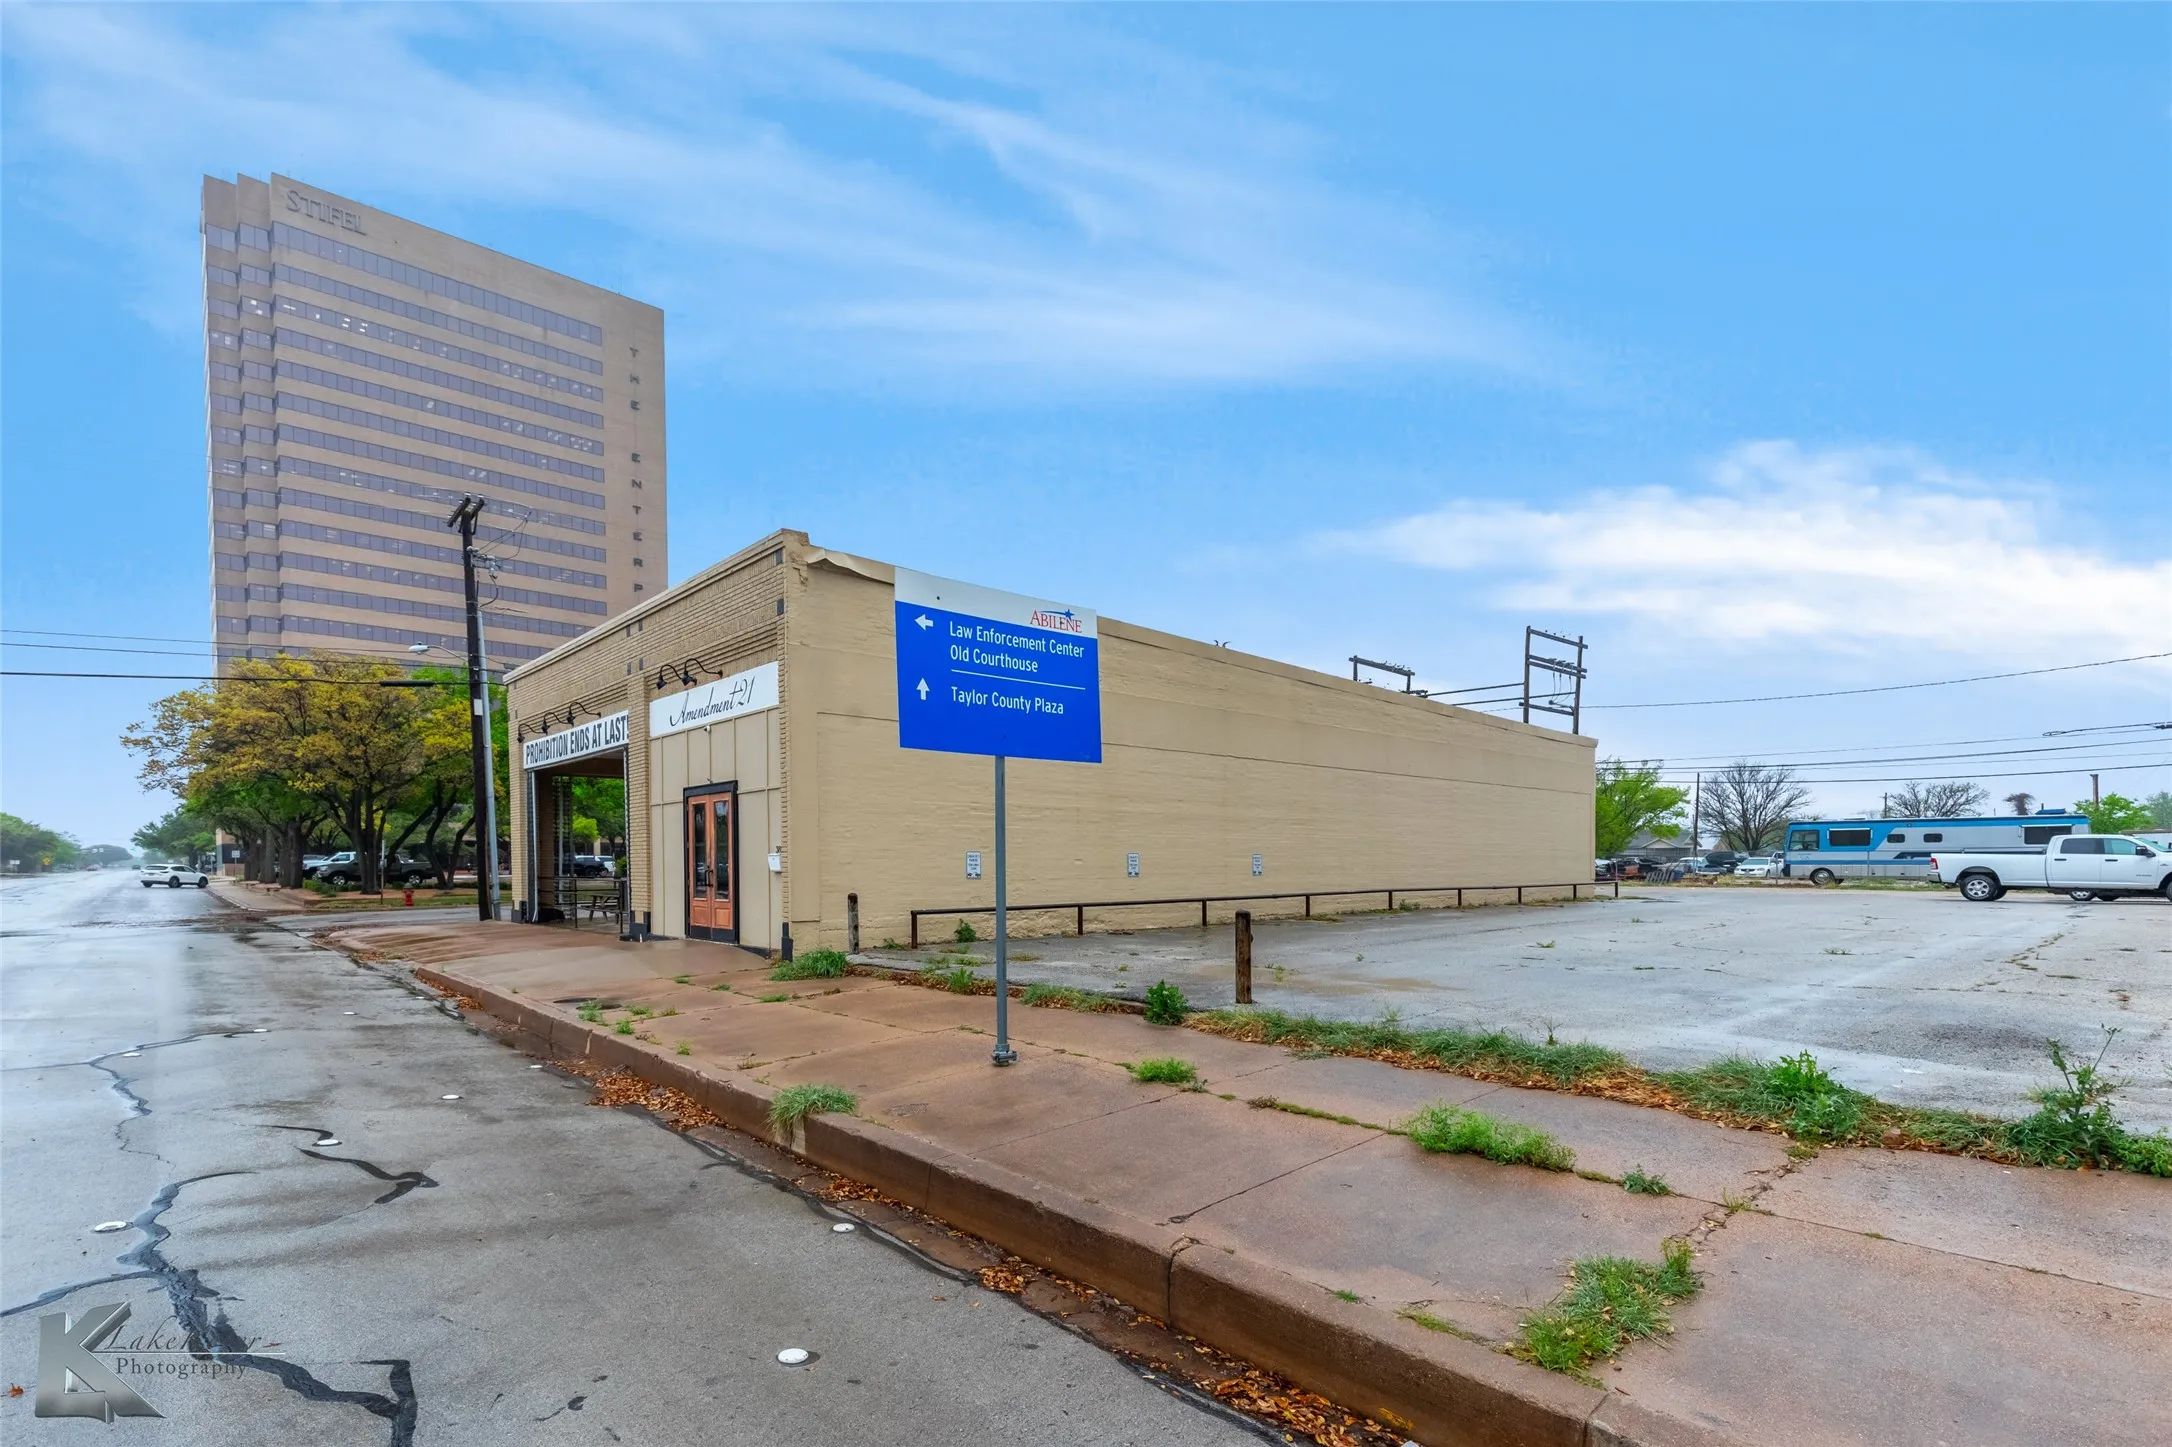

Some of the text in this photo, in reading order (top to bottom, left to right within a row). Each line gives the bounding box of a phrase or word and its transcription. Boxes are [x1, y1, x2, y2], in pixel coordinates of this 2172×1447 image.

[287, 190, 367, 236] STIFEL
[950, 621, 1084, 658] Law Enforcement Center
[1030, 610, 1082, 633] ABILENE
[950, 644, 1038, 672] Old Courthouse
[670, 676, 756, 727] Amendment 21
[951, 686, 1064, 714] Taylor County Plaza
[526, 734, 568, 765] PROHIBITION
[570, 726, 590, 754] ENDS
[592, 723, 602, 749] AT
